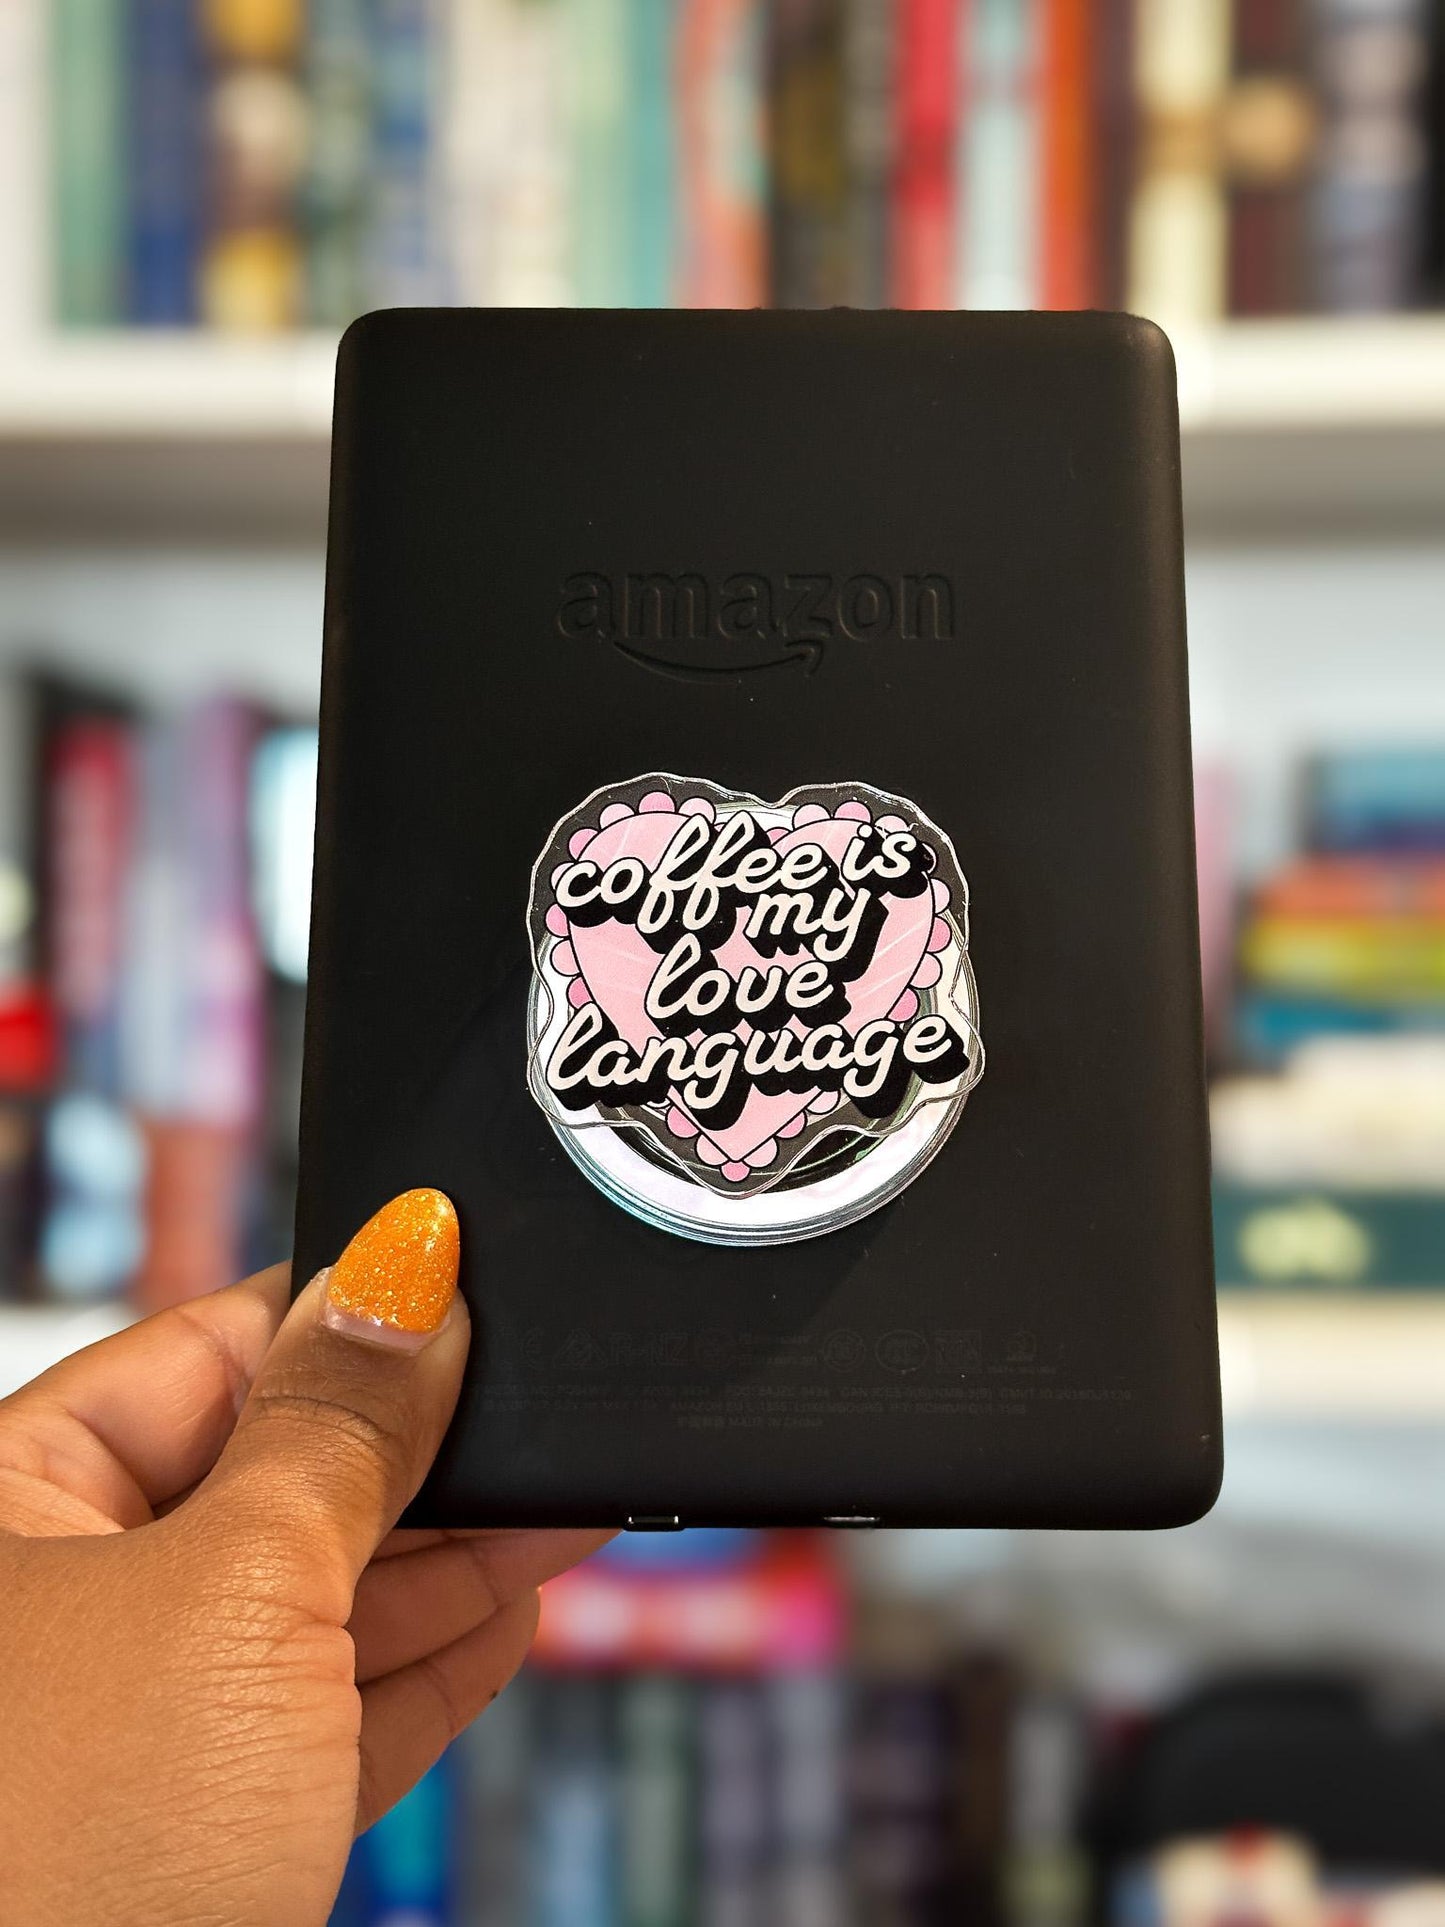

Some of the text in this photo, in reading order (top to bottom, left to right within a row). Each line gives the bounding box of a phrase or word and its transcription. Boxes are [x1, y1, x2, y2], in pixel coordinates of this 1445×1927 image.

[557, 571, 955, 643] amazon
[554, 810, 919, 935] coffee is
[743, 886, 873, 964] my
[643, 932, 836, 1021] love
[546, 1000, 954, 1111] language
